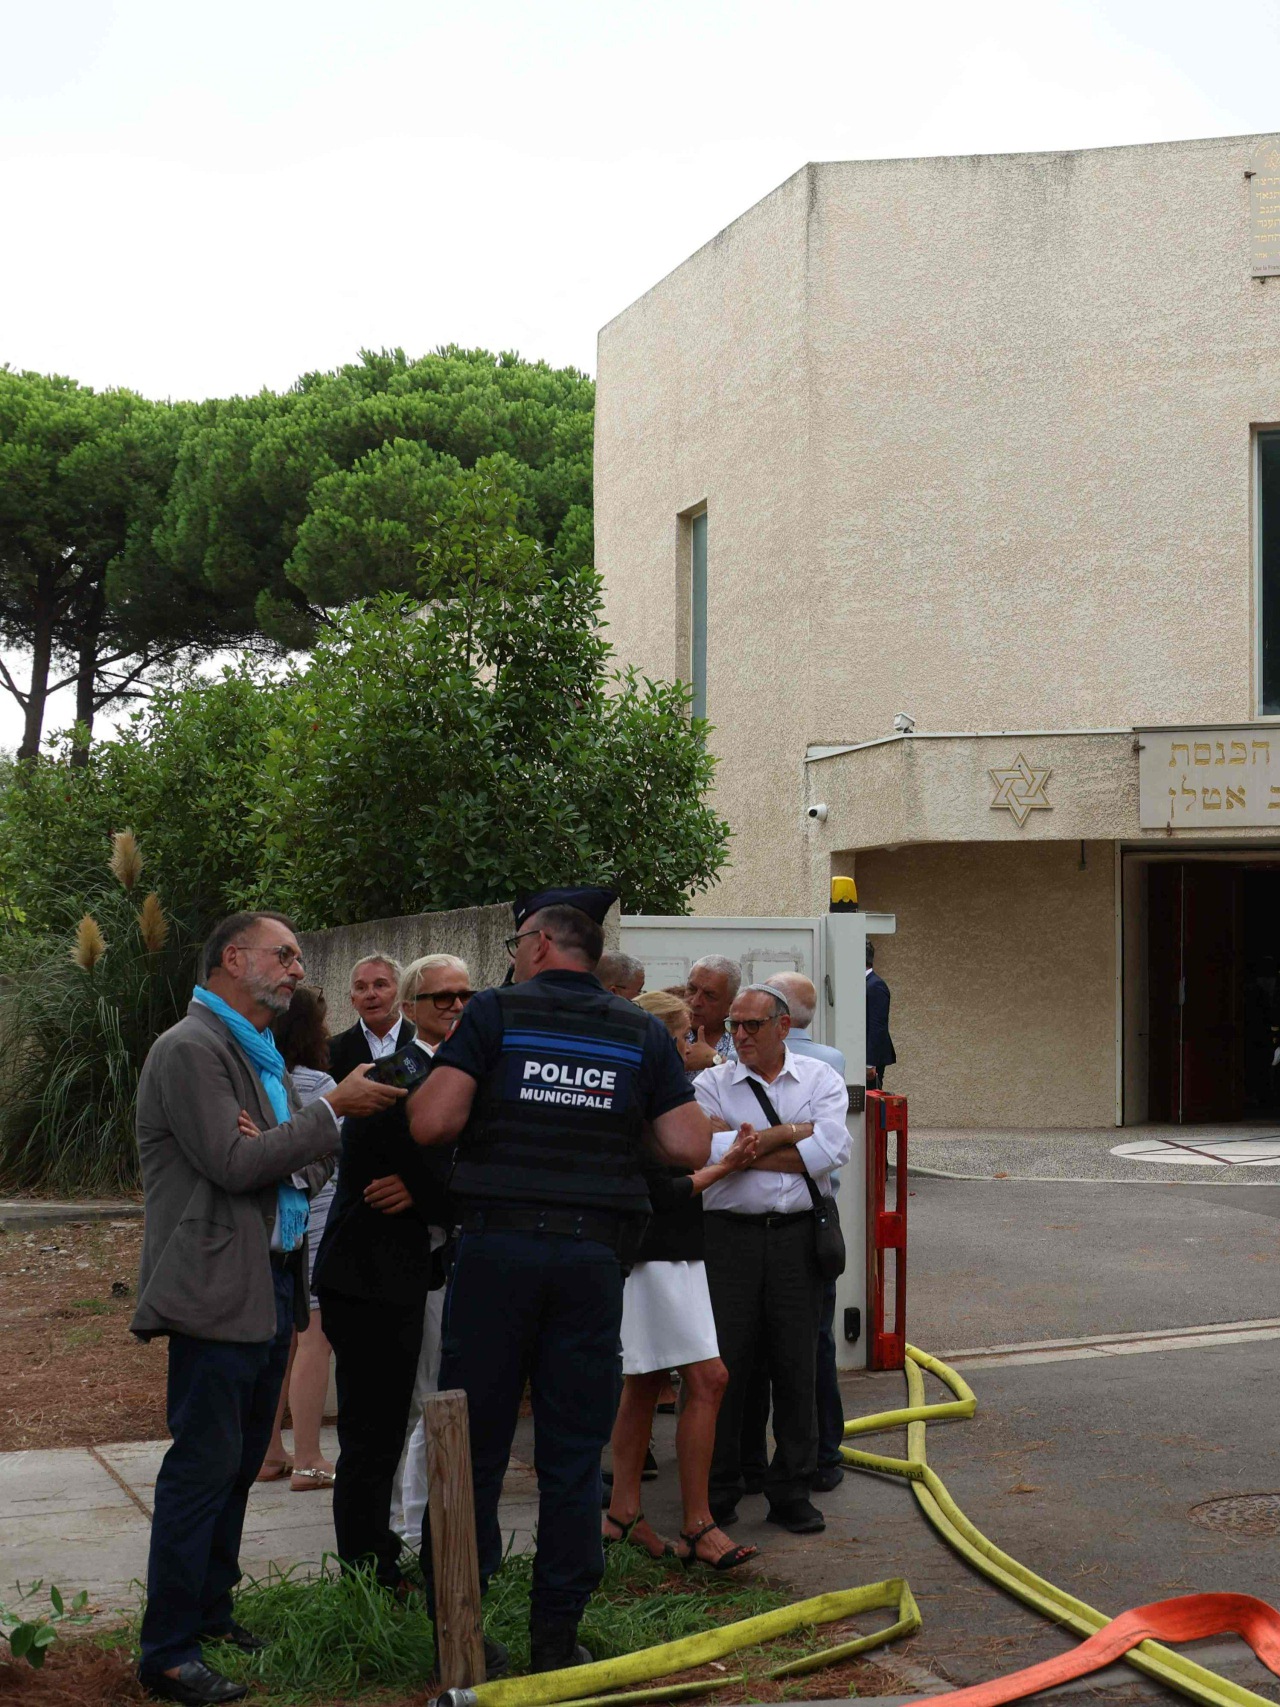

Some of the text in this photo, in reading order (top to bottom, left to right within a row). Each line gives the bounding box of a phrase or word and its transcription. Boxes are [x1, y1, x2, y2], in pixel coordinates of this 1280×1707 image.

[1168, 739, 1271, 768] הכנסת
[1168, 774, 1247, 819] אטלן
[523, 1060, 617, 1090] POLICE
[519, 1087, 613, 1109] MUNICIPALE
